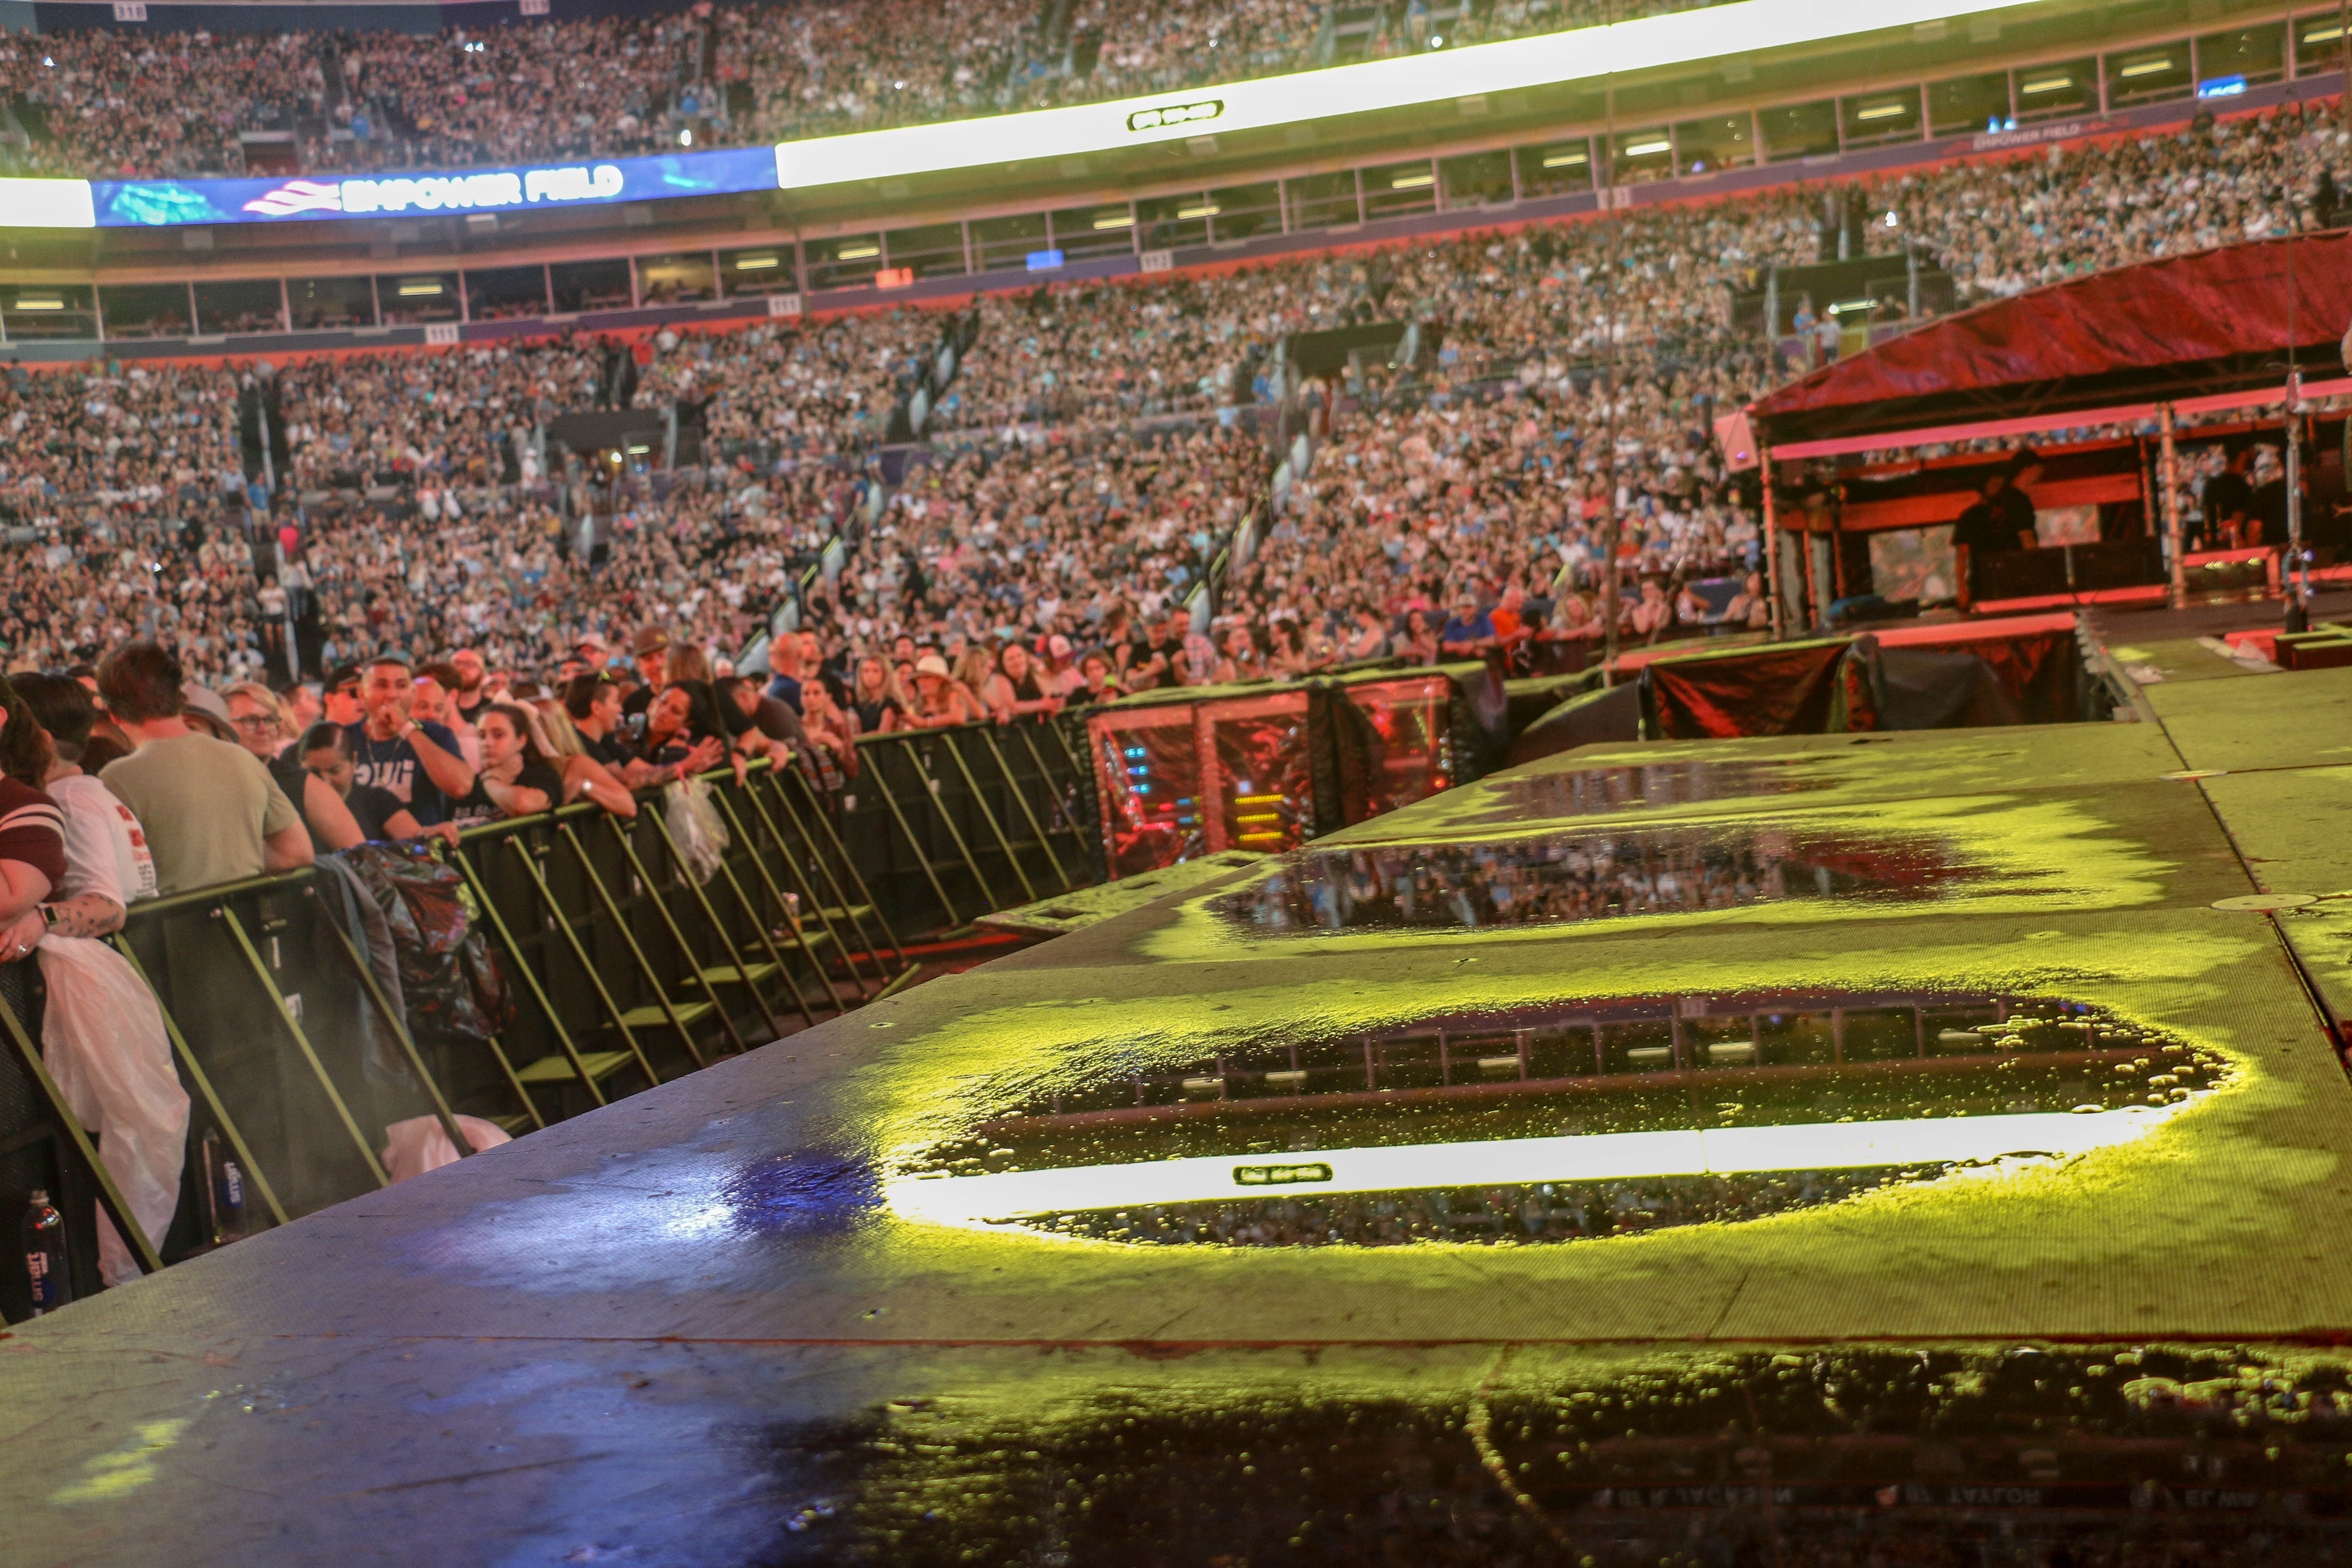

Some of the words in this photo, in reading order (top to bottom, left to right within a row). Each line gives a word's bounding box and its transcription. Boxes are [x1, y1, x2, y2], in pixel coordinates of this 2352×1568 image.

[1972, 130, 2040, 151] EMPOWER
[2043, 123, 2081, 138] FIELD
[341, 173, 523, 212] EMPOWER
[524, 165, 624, 202] FIELD
